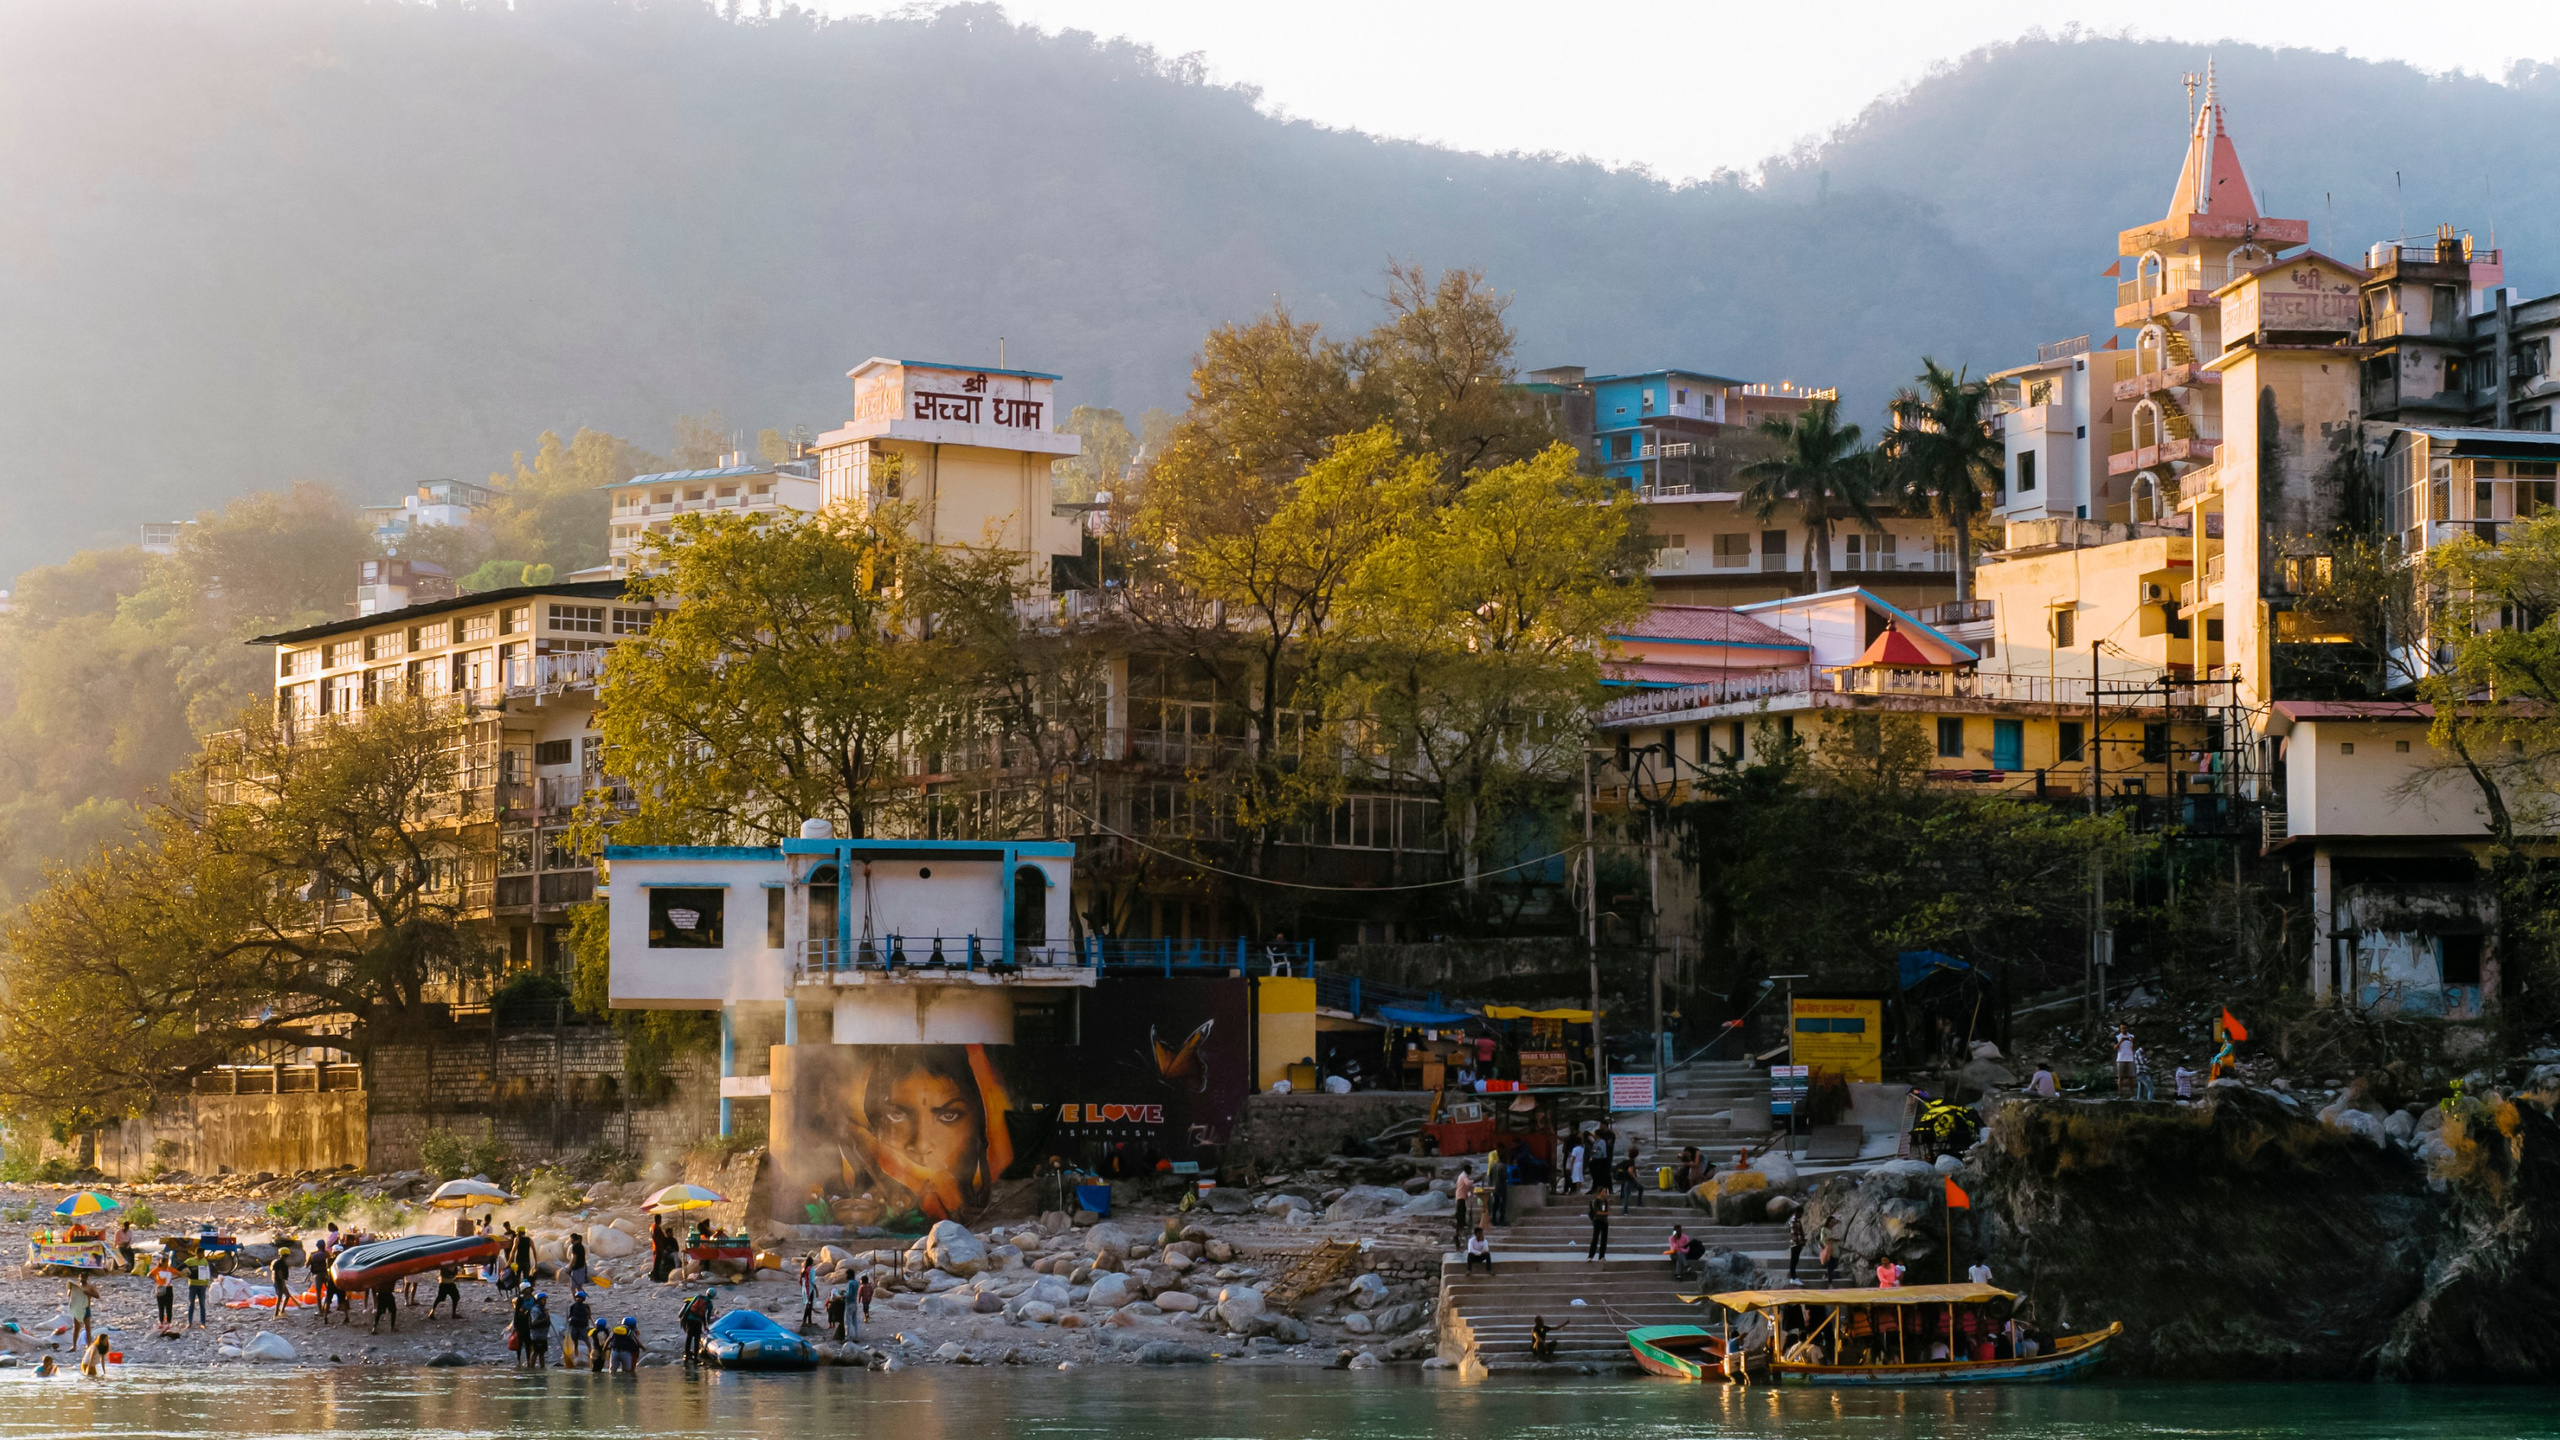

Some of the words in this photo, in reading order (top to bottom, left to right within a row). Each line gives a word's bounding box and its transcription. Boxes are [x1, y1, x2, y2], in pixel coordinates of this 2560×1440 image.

[962, 373, 988, 393] श्री
[914, 391, 983, 424] सच्चा
[992, 398, 1044, 431] धाम
[1085, 1103, 1164, 1123] LOVE
[1058, 1128, 1155, 1137] ISHIKESH
